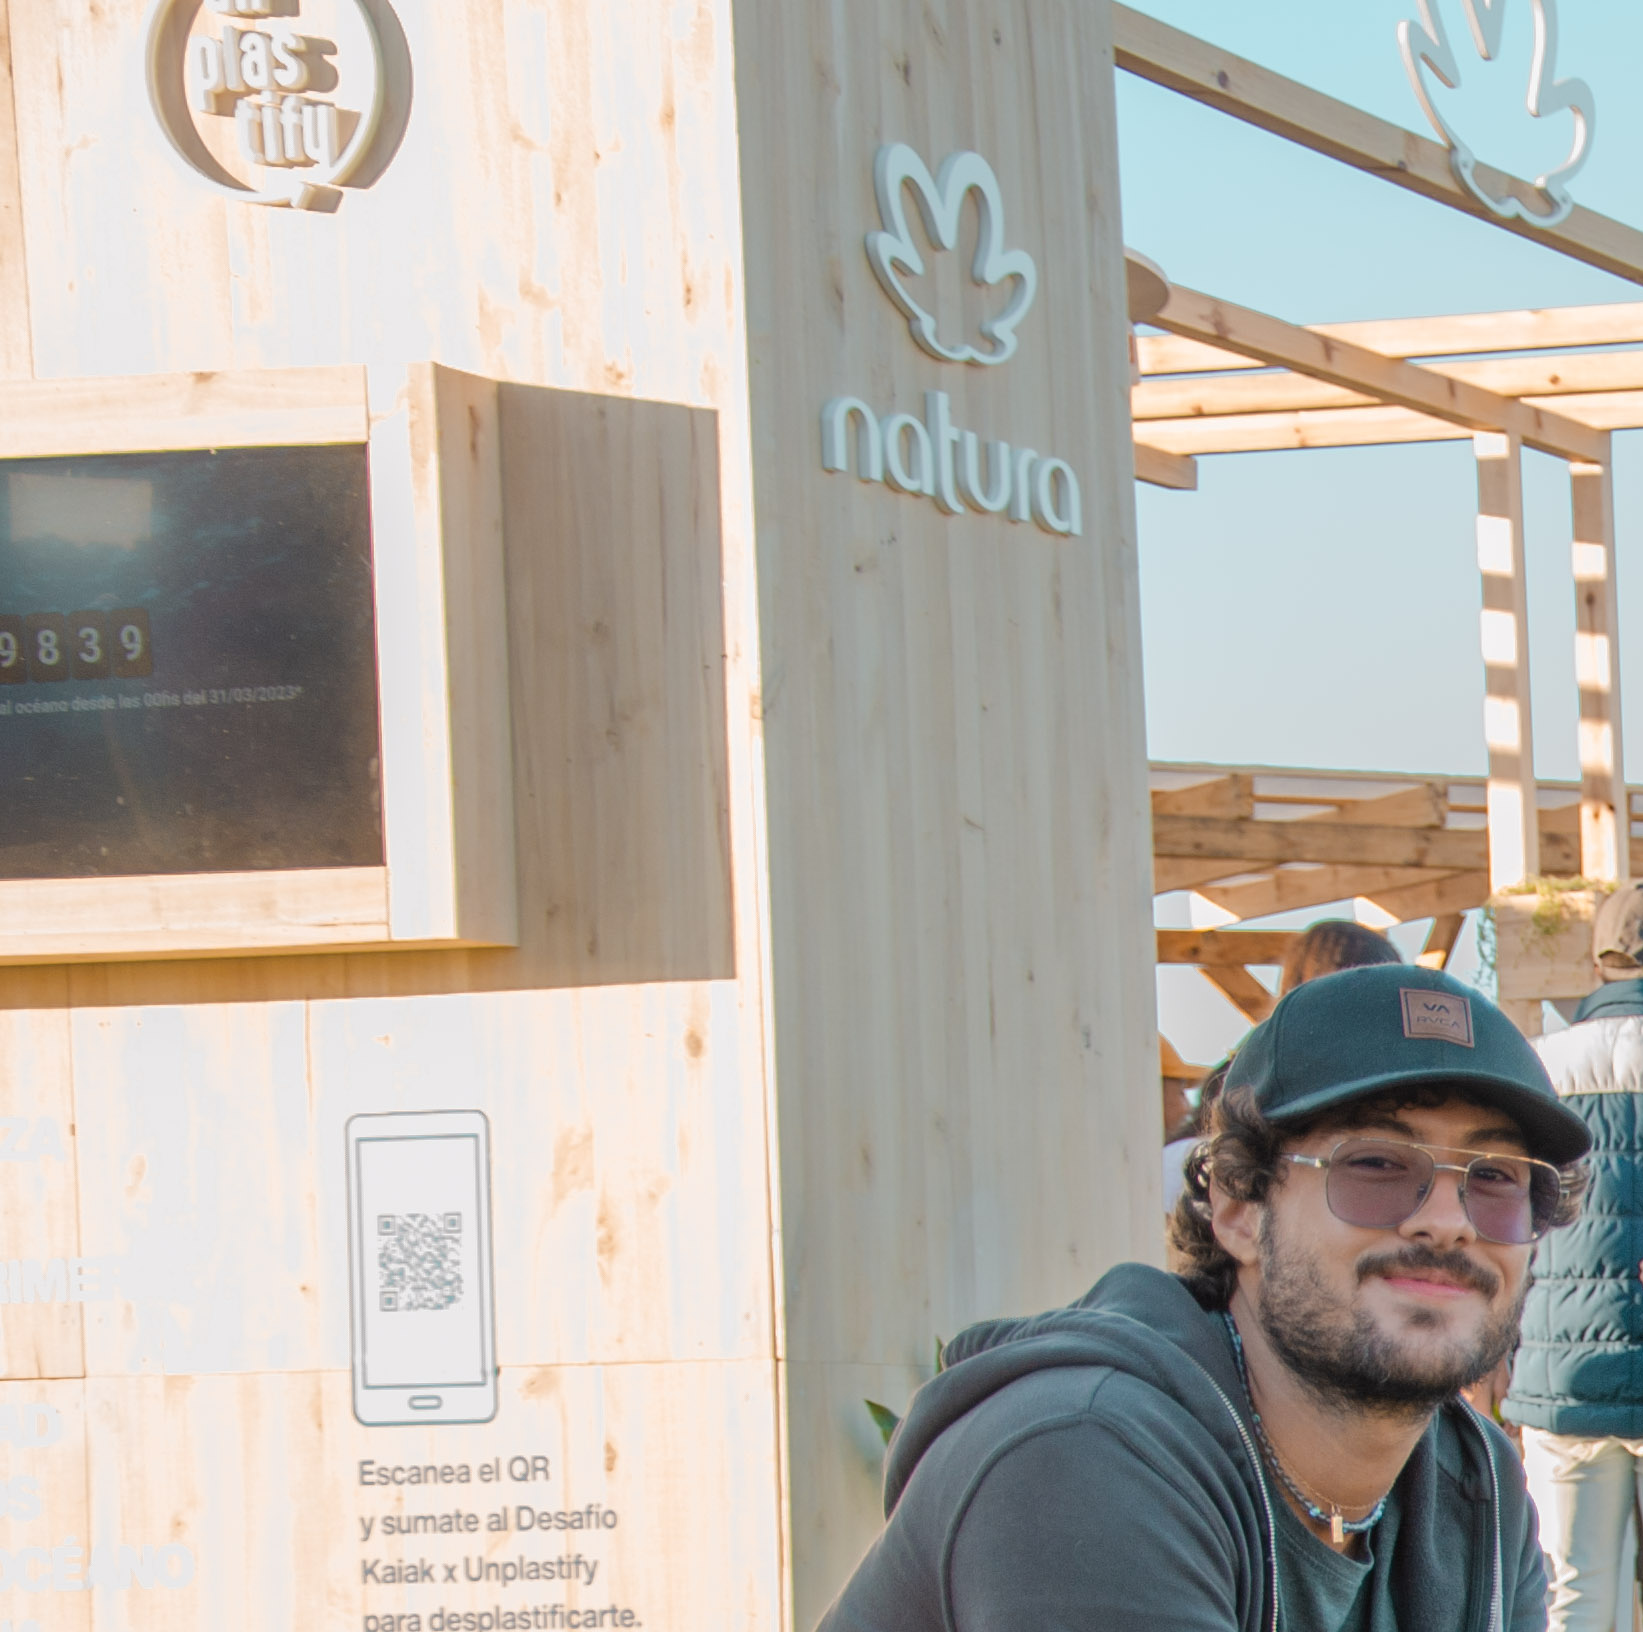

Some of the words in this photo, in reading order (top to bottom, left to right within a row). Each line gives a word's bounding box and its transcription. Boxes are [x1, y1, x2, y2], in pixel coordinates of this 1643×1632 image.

[189, 25, 305, 112] plas
[234, 90, 338, 168] tify
[819, 389, 1083, 538] natura
[71, 695, 115, 711] desde
[358, 1459, 471, 1486] Escanea
[478, 1457, 500, 1482] el
[508, 1455, 550, 1482] QR
[360, 1515, 375, 1542] y
[381, 1509, 479, 1535] sumate
[486, 1506, 508, 1532] al
[0, 1535, 196, 1593] CÉANO
[361, 1557, 436, 1584] Kaiak
[442, 1563, 458, 1584] x
[463, 1553, 599, 1588] Unplastify
